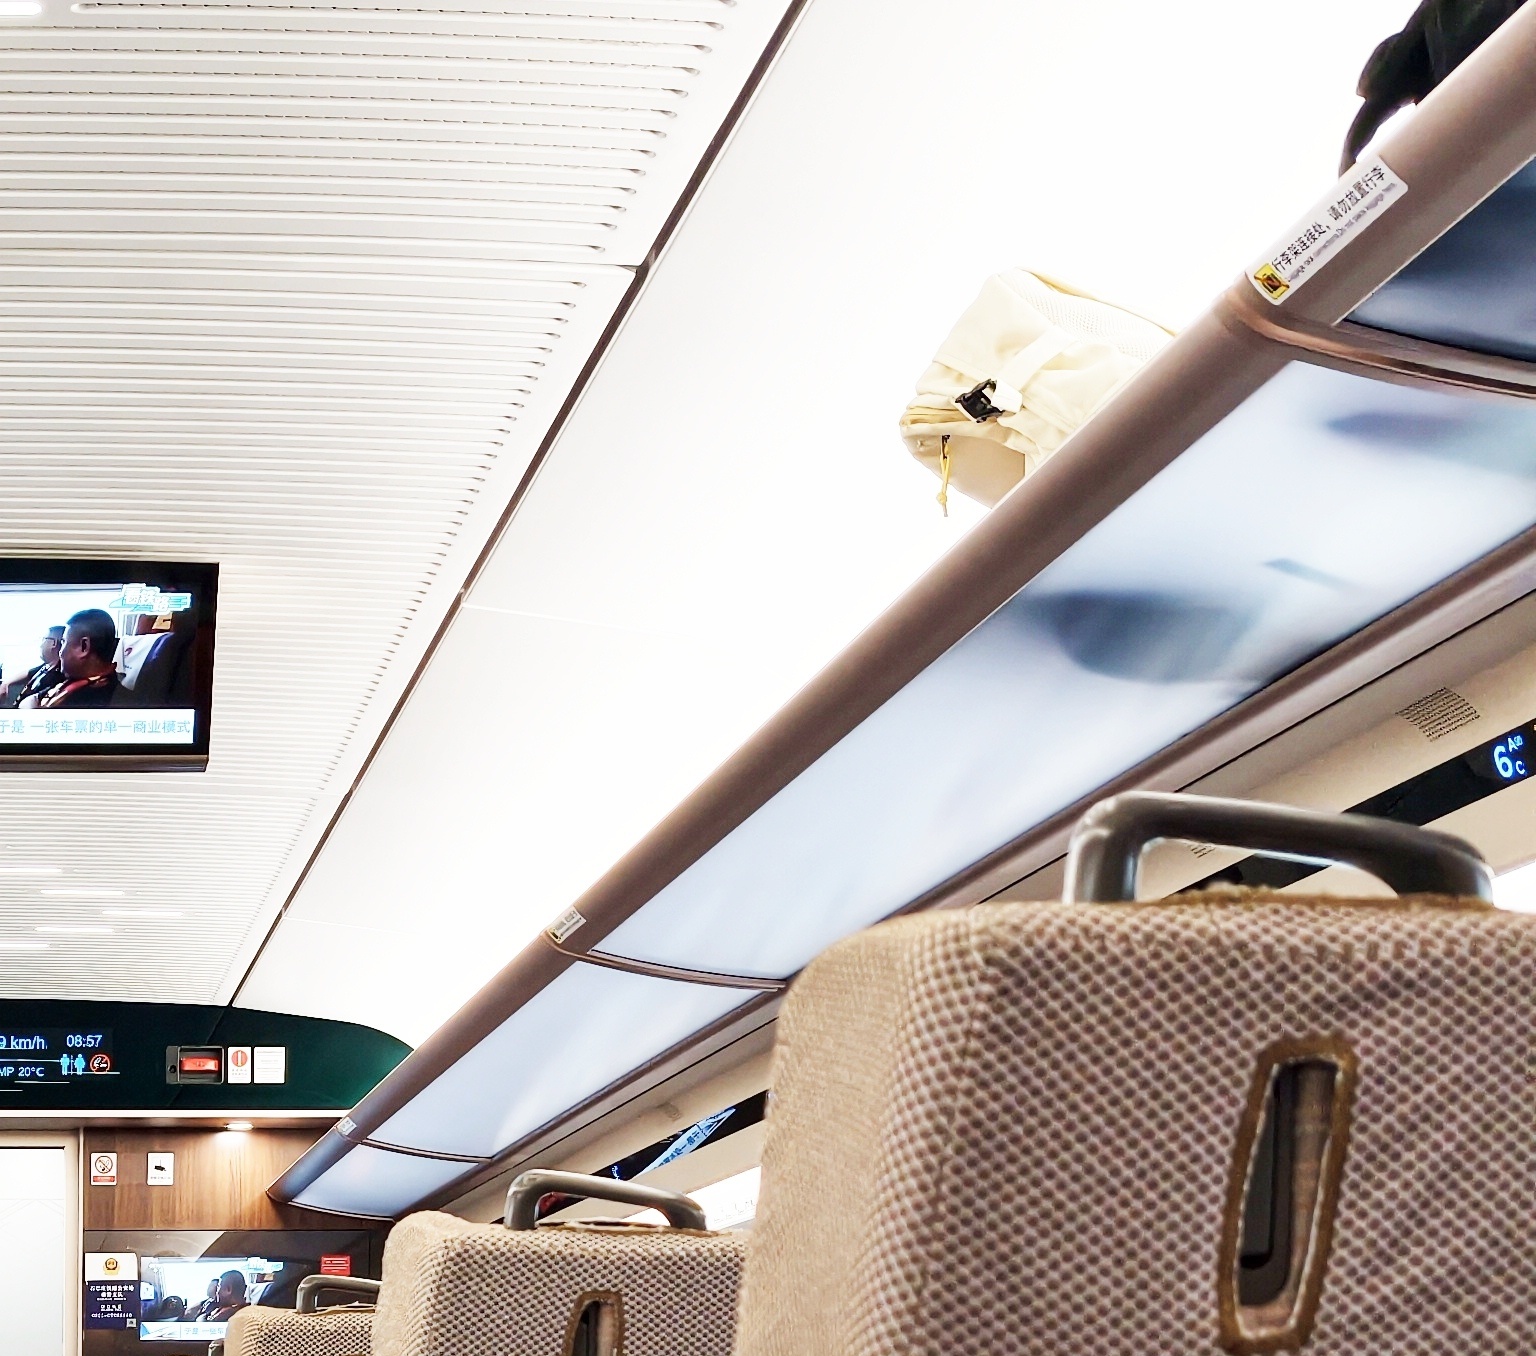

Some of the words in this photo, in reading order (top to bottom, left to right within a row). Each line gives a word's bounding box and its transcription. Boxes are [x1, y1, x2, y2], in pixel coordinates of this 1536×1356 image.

[1493, 745, 1513, 778] 6
[1515, 760, 1526, 775] C
[66, 1035, 103, 1048] 08:57
